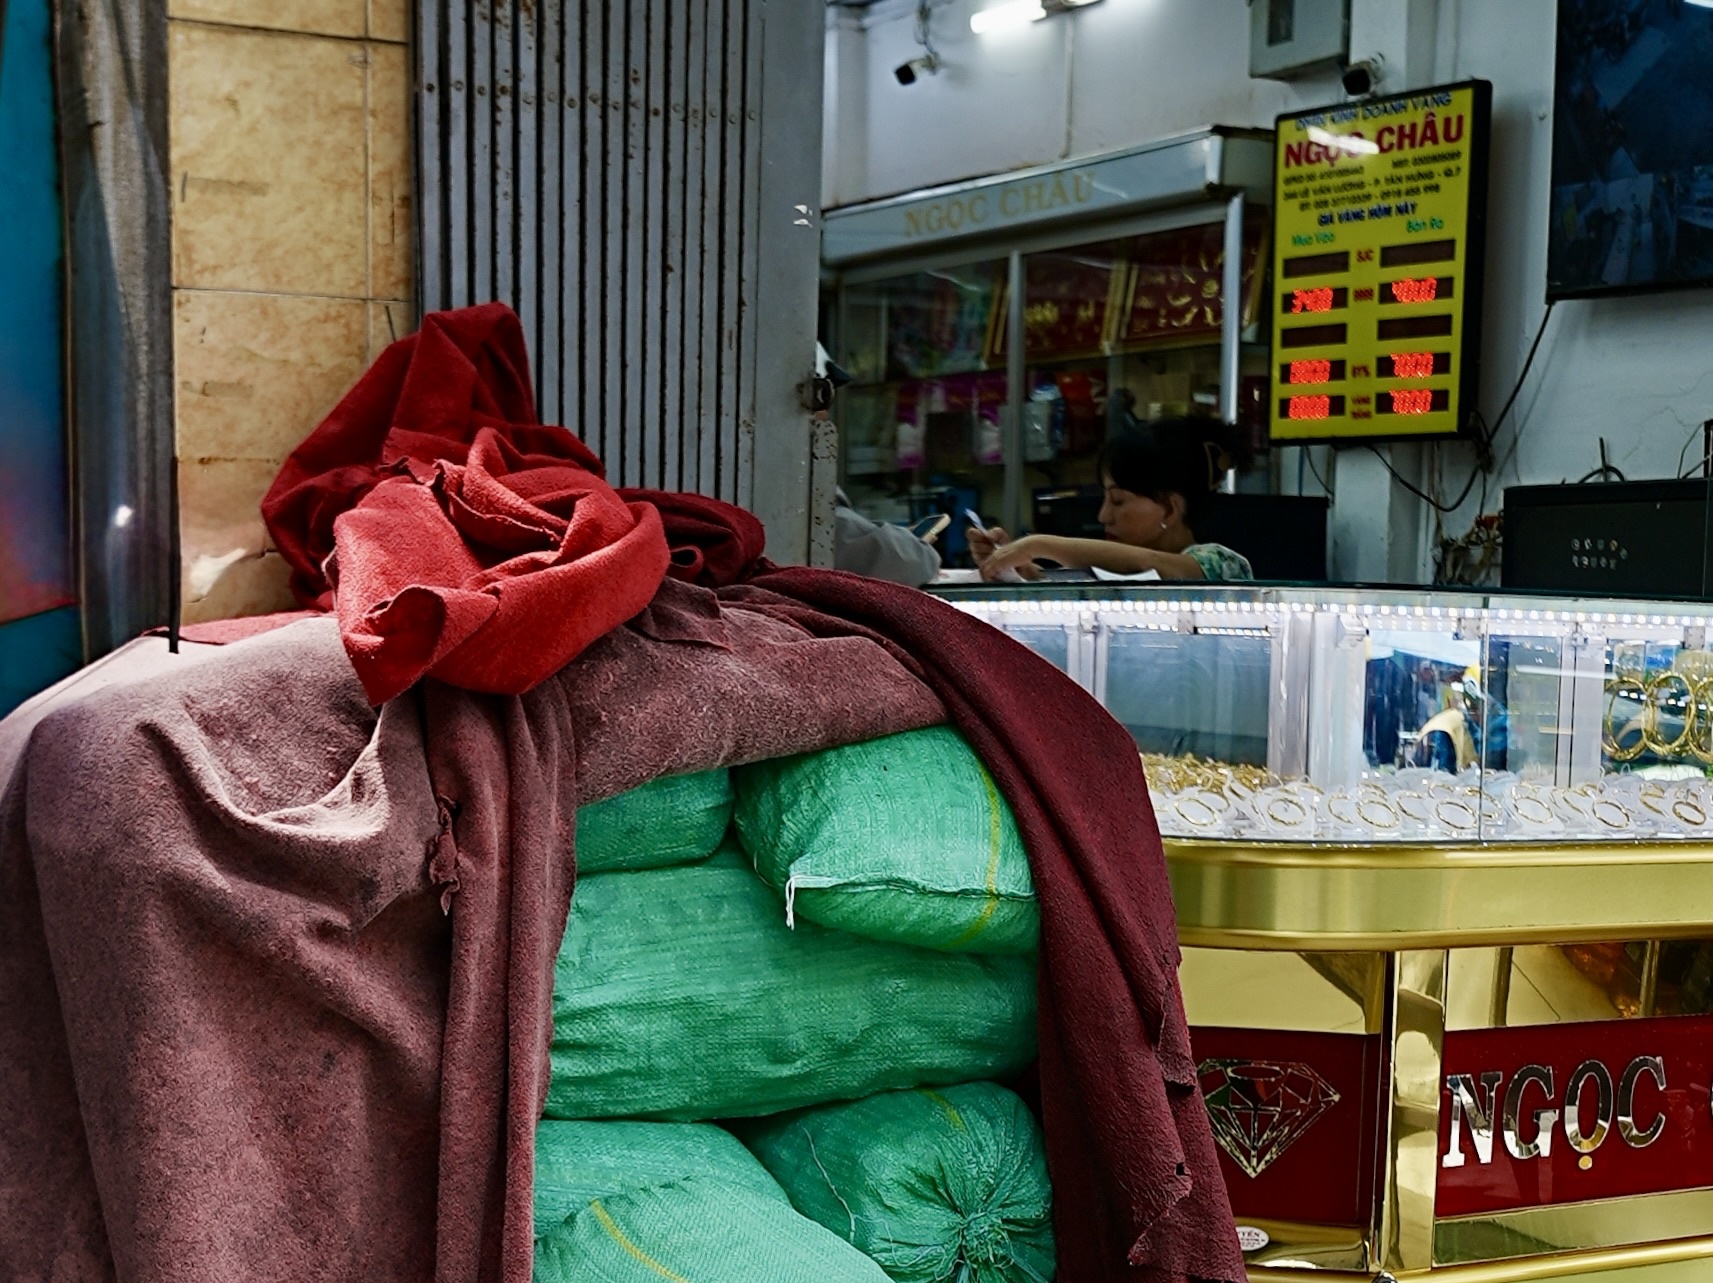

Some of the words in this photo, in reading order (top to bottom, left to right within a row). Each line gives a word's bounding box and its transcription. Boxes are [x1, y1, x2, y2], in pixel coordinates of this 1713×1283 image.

[1362, 100, 1408, 120] DOANH
[1376, 111, 1464, 153] CHÂU
[1441, 1055, 1666, 1170] NGỌC
